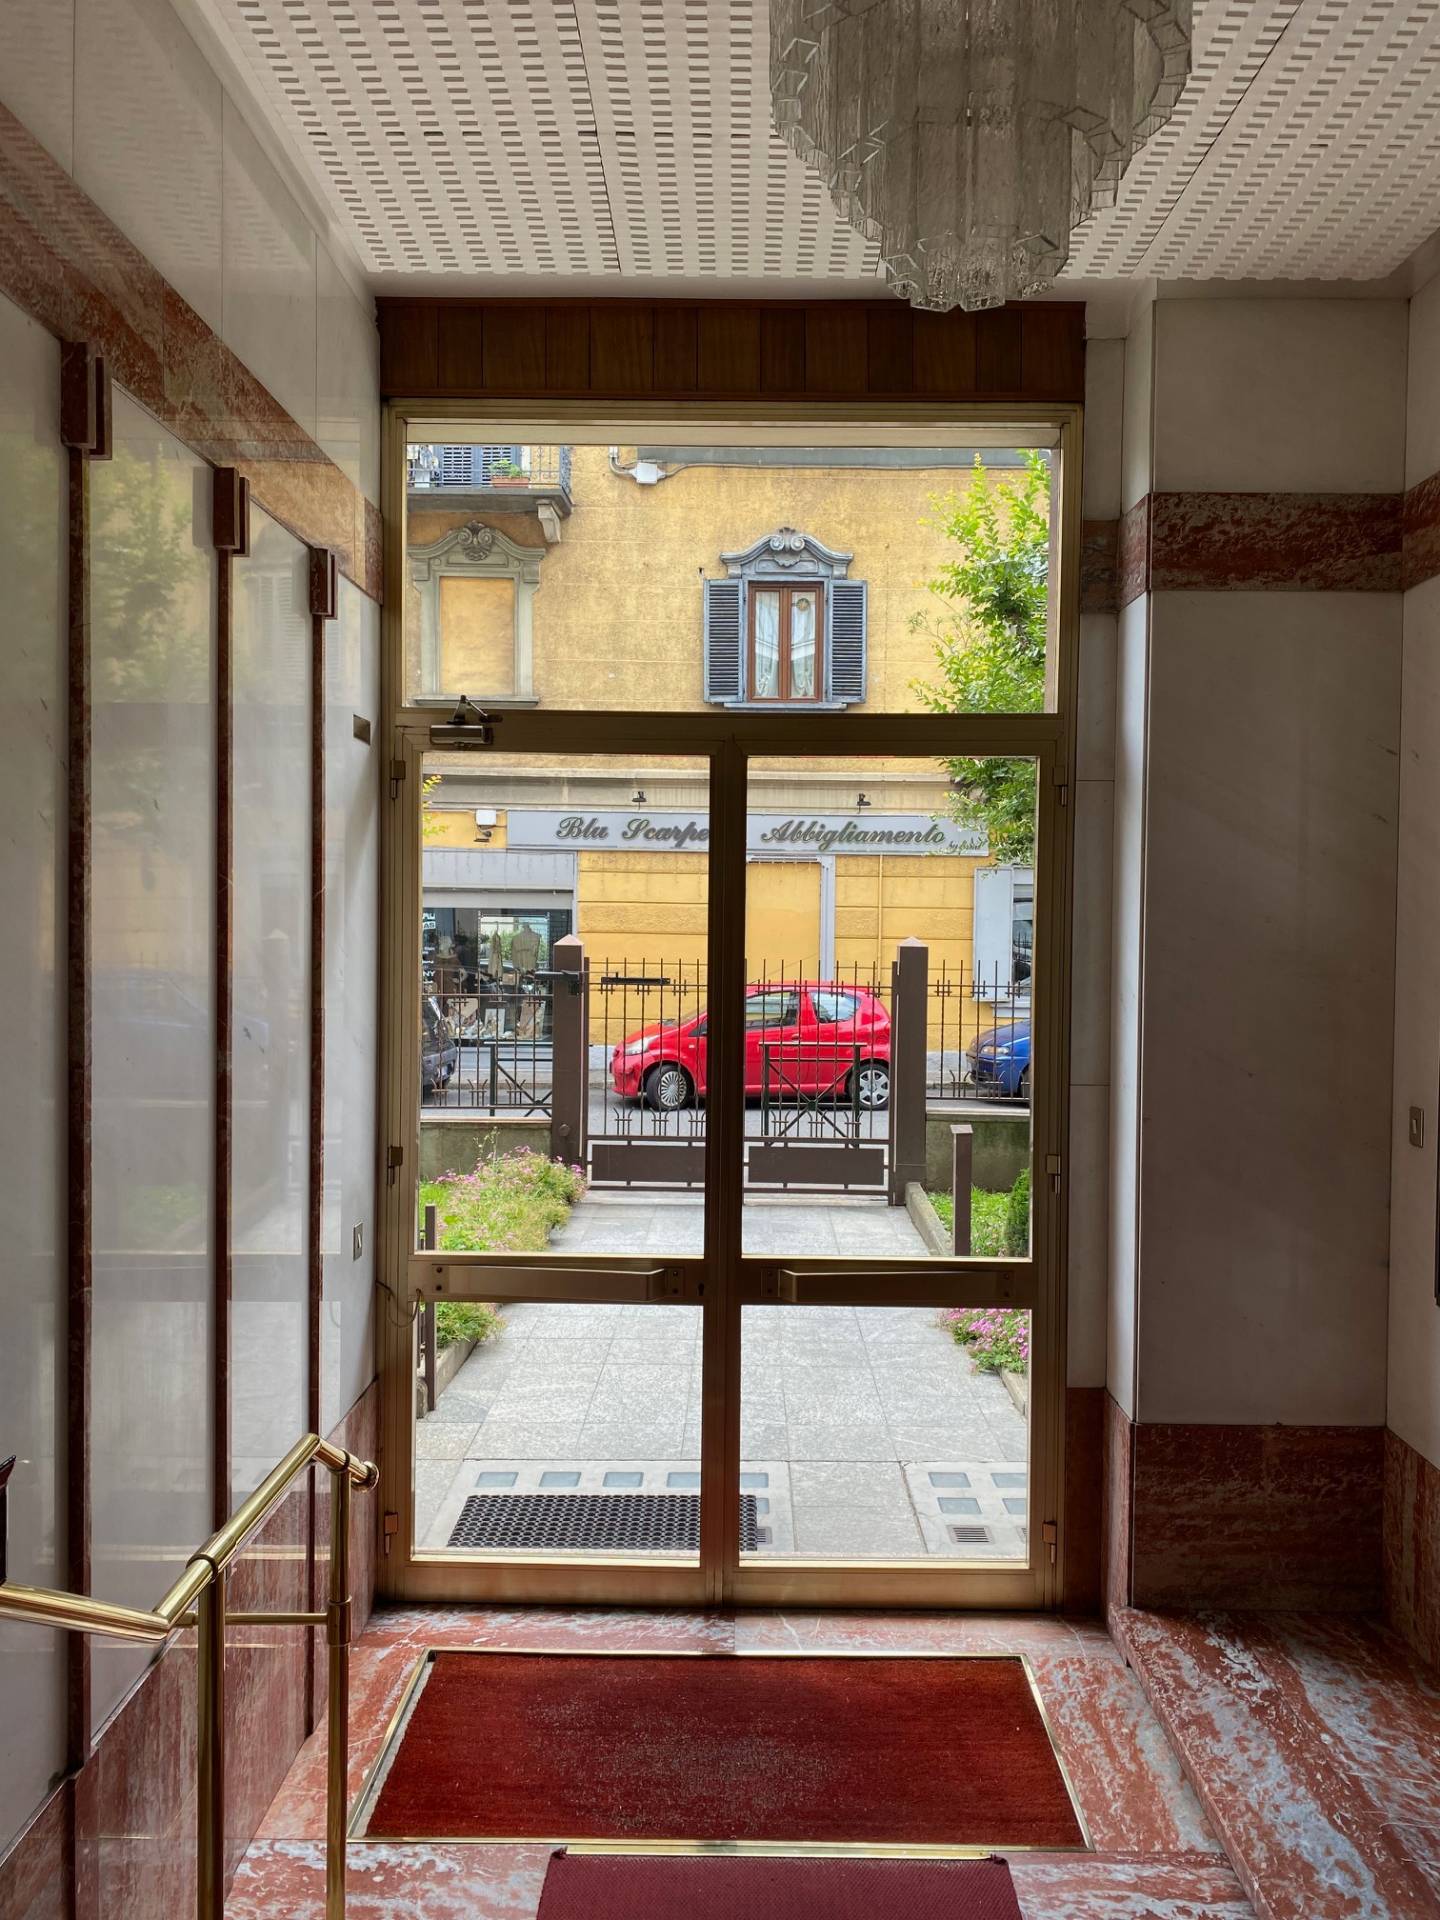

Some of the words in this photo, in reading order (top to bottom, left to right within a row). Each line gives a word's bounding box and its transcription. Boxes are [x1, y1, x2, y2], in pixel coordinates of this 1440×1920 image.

[556, 816, 608, 840] Blu
[621, 818, 709, 848] Scarpe
[760, 819, 945, 850] Abbigliamento
